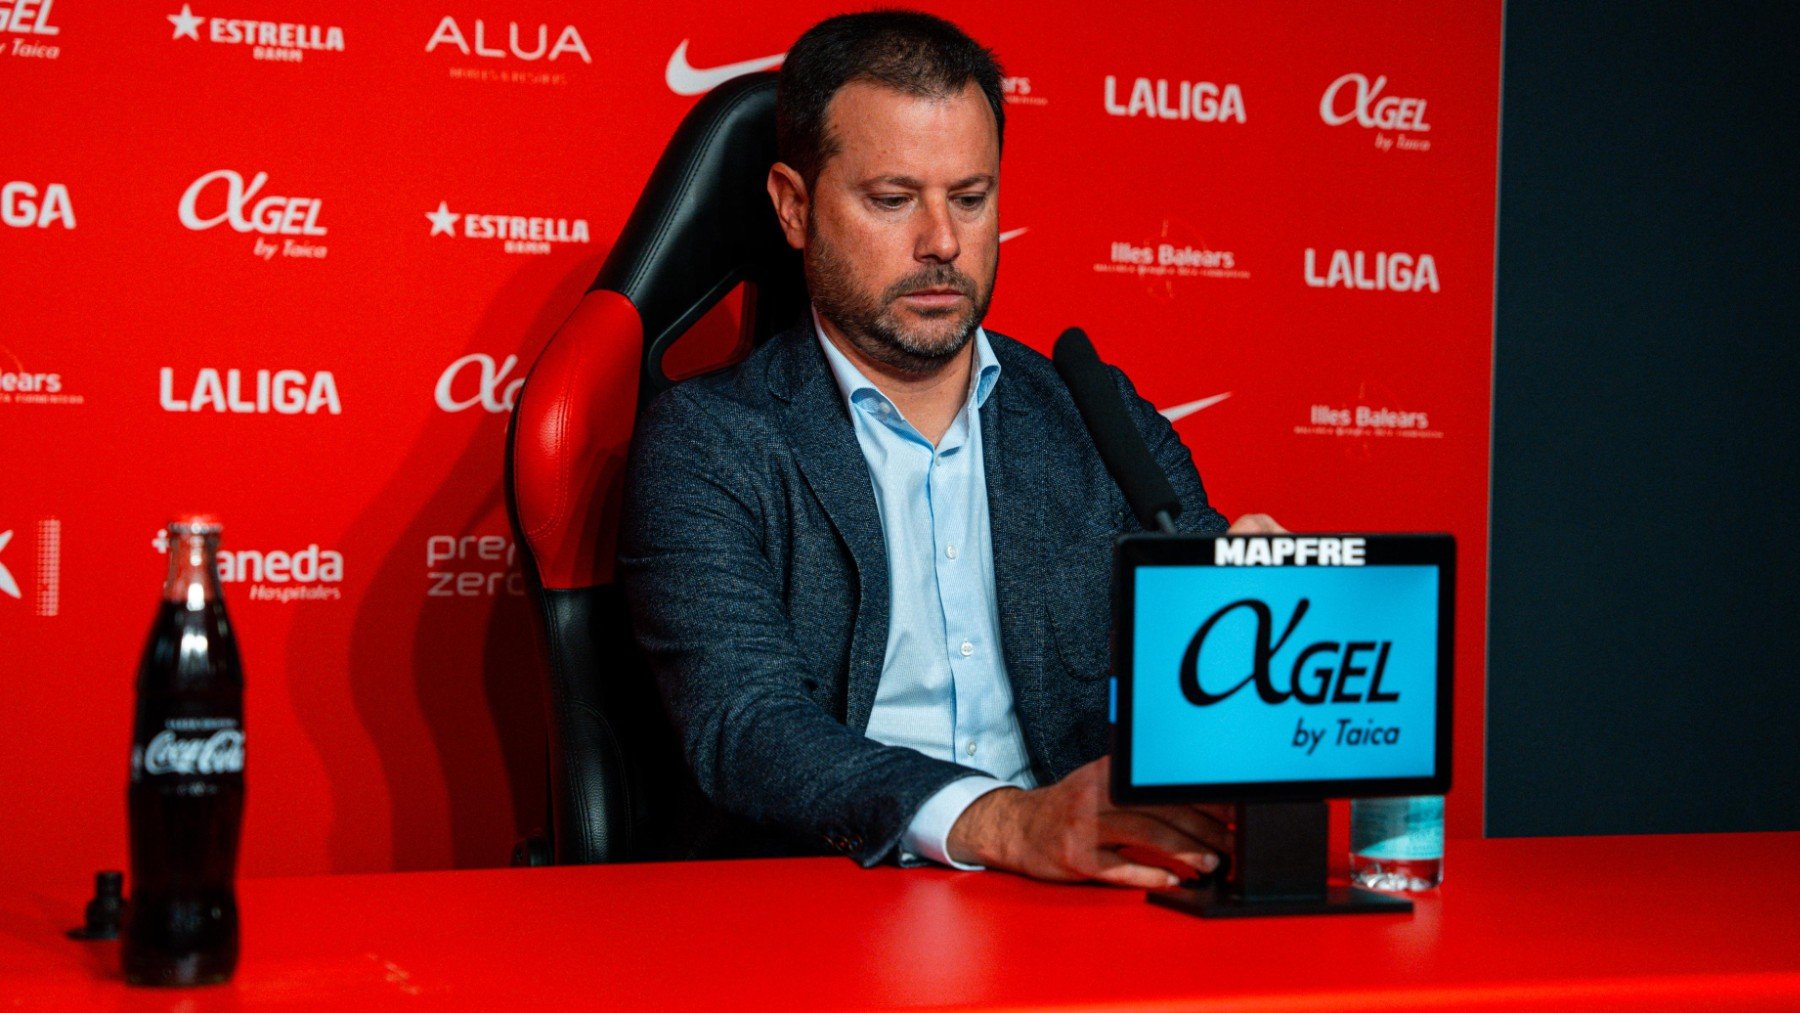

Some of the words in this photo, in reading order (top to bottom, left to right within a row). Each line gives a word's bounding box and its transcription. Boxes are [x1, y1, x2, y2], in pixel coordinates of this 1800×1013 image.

[210, 18, 344, 51] ESTRELLA
[425, 16, 592, 63] ALUA
[1104, 75, 1246, 123] LALIGA
[465, 214, 590, 243] ESTRELLA
[1158, 244, 1235, 268] Balears
[1304, 248, 1440, 293] LALIGA
[0, 372, 61, 392] ears
[159, 366, 342, 415] LALIGA
[1355, 406, 1429, 429] Balears
[216, 544, 344, 583] aneda
[1214, 538, 1366, 566] MAPFRE
[1291, 718, 1326, 756] by
[1335, 718, 1400, 746] Taica
